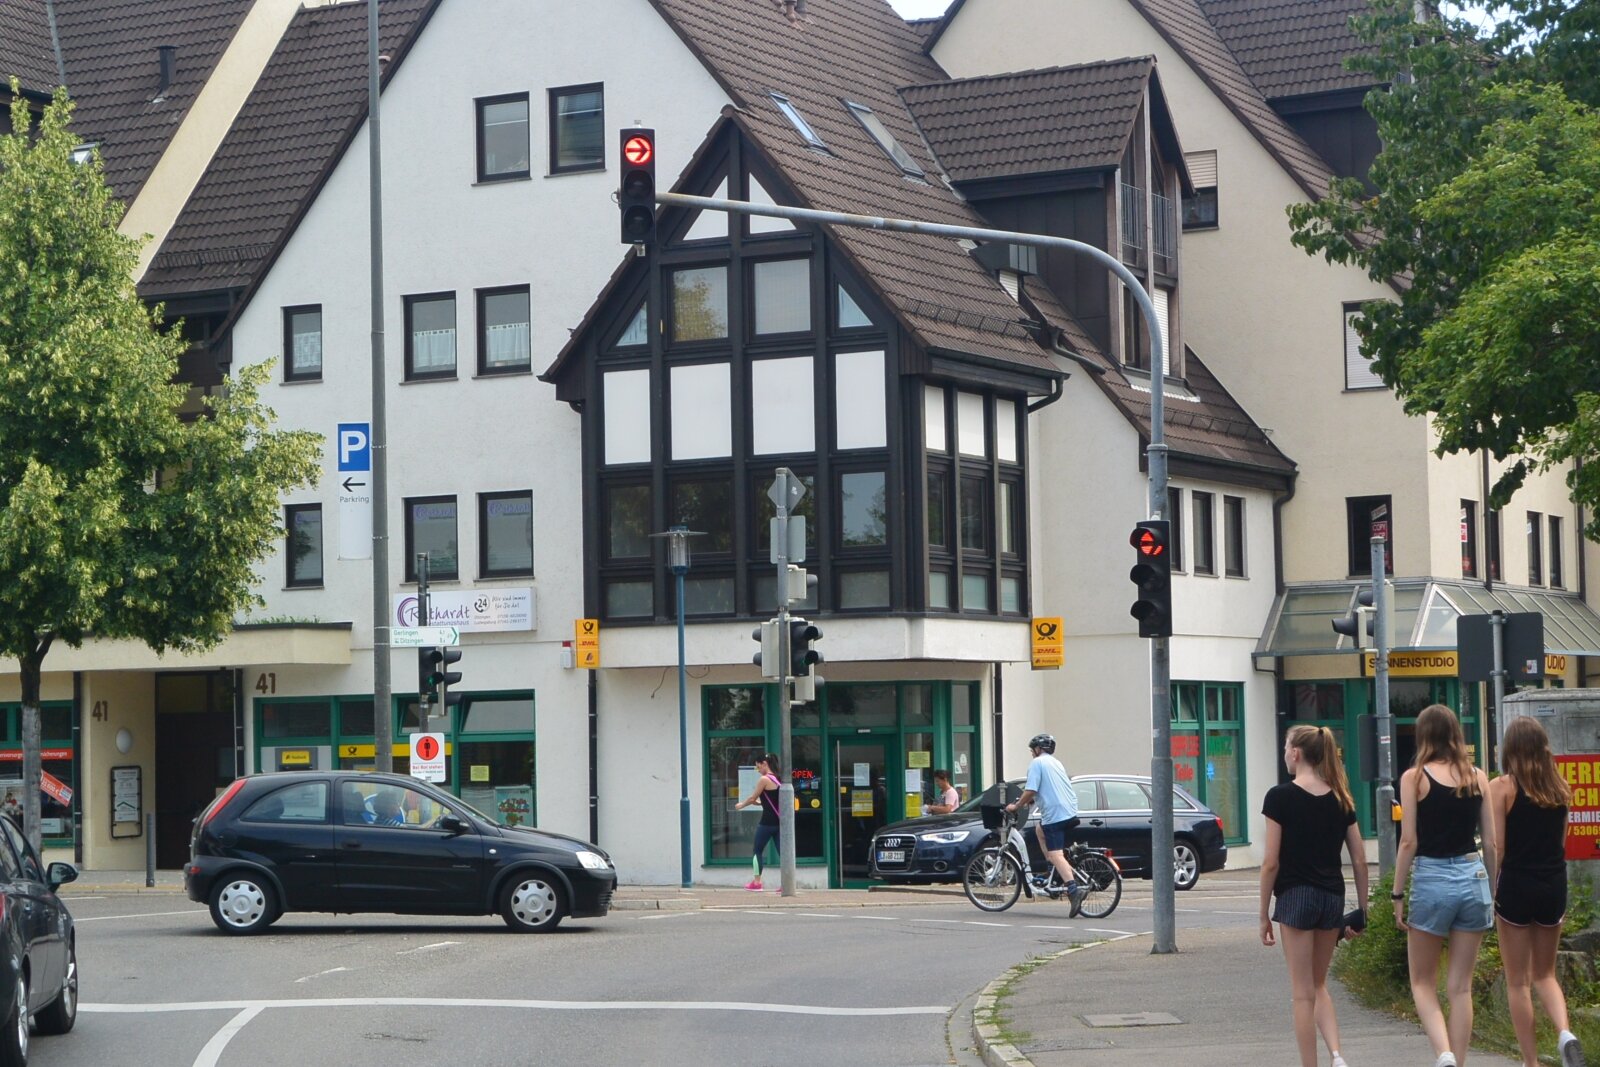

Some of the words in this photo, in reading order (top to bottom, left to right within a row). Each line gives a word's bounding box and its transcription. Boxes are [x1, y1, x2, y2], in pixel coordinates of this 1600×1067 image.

[341, 430, 367, 463] P
[340, 496, 370, 504] Parkring
[478, 598, 488, 608] 24
[405, 604, 469, 622] Rthardt
[1368, 656, 1455, 669] SNNENSTUDIO
[256, 672, 276, 694] 41
[92, 700, 108, 722] 41
[1568, 812, 1600, 823] ERMIE
